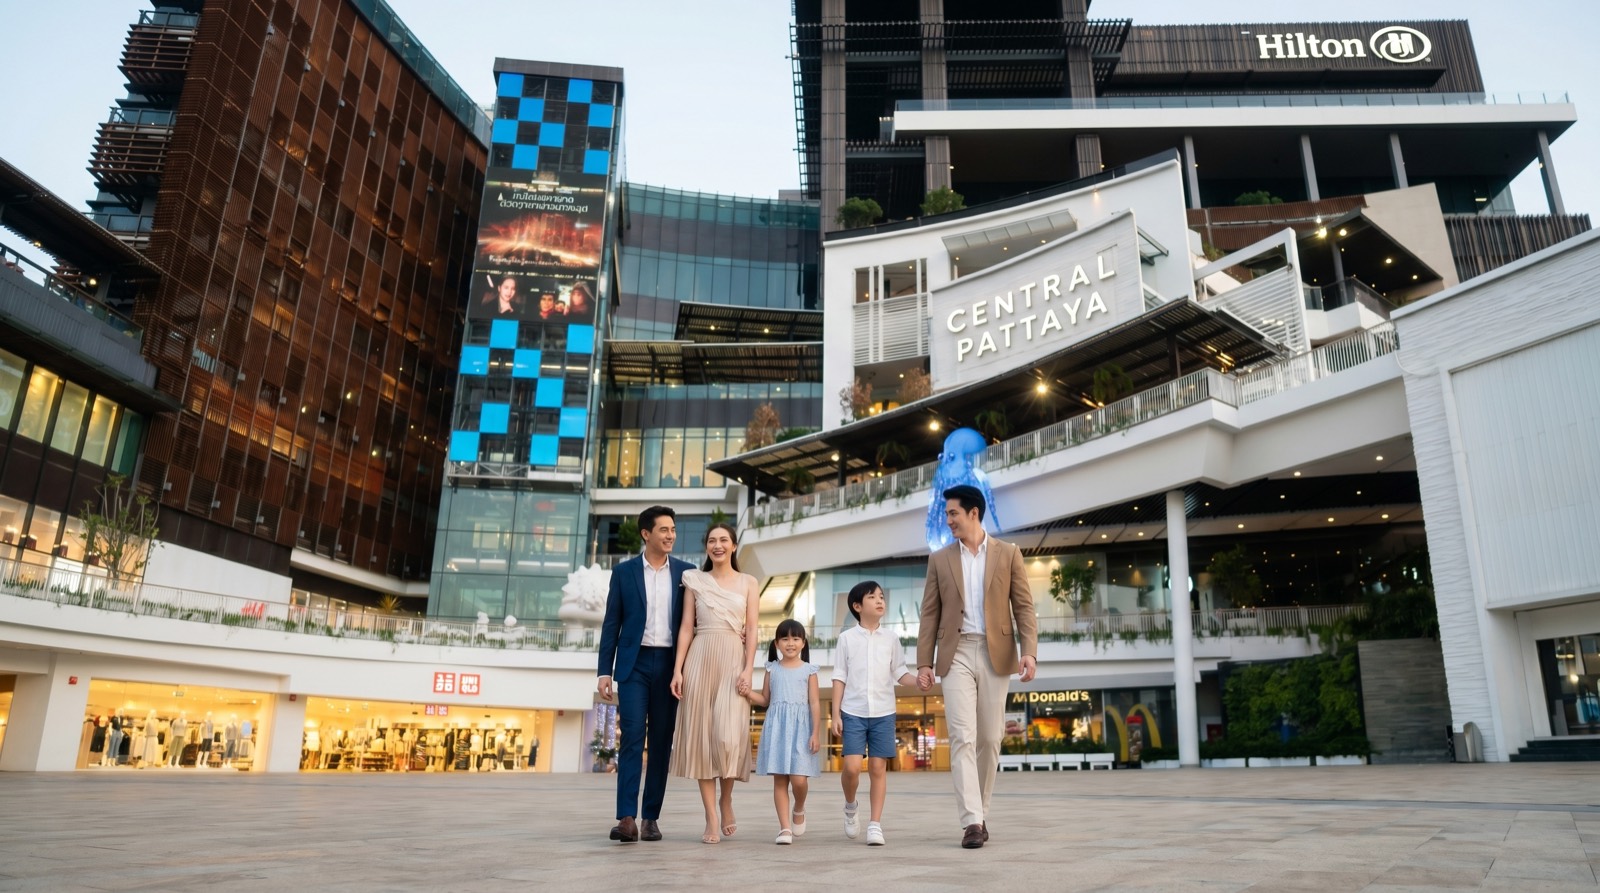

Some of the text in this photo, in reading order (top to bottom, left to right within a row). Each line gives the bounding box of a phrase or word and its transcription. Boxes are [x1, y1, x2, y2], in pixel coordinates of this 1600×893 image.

[1255, 32, 1367, 60] Hilton
[946, 255, 1116, 333] CENTRAL
[957, 291, 1108, 363] PATTAYA
